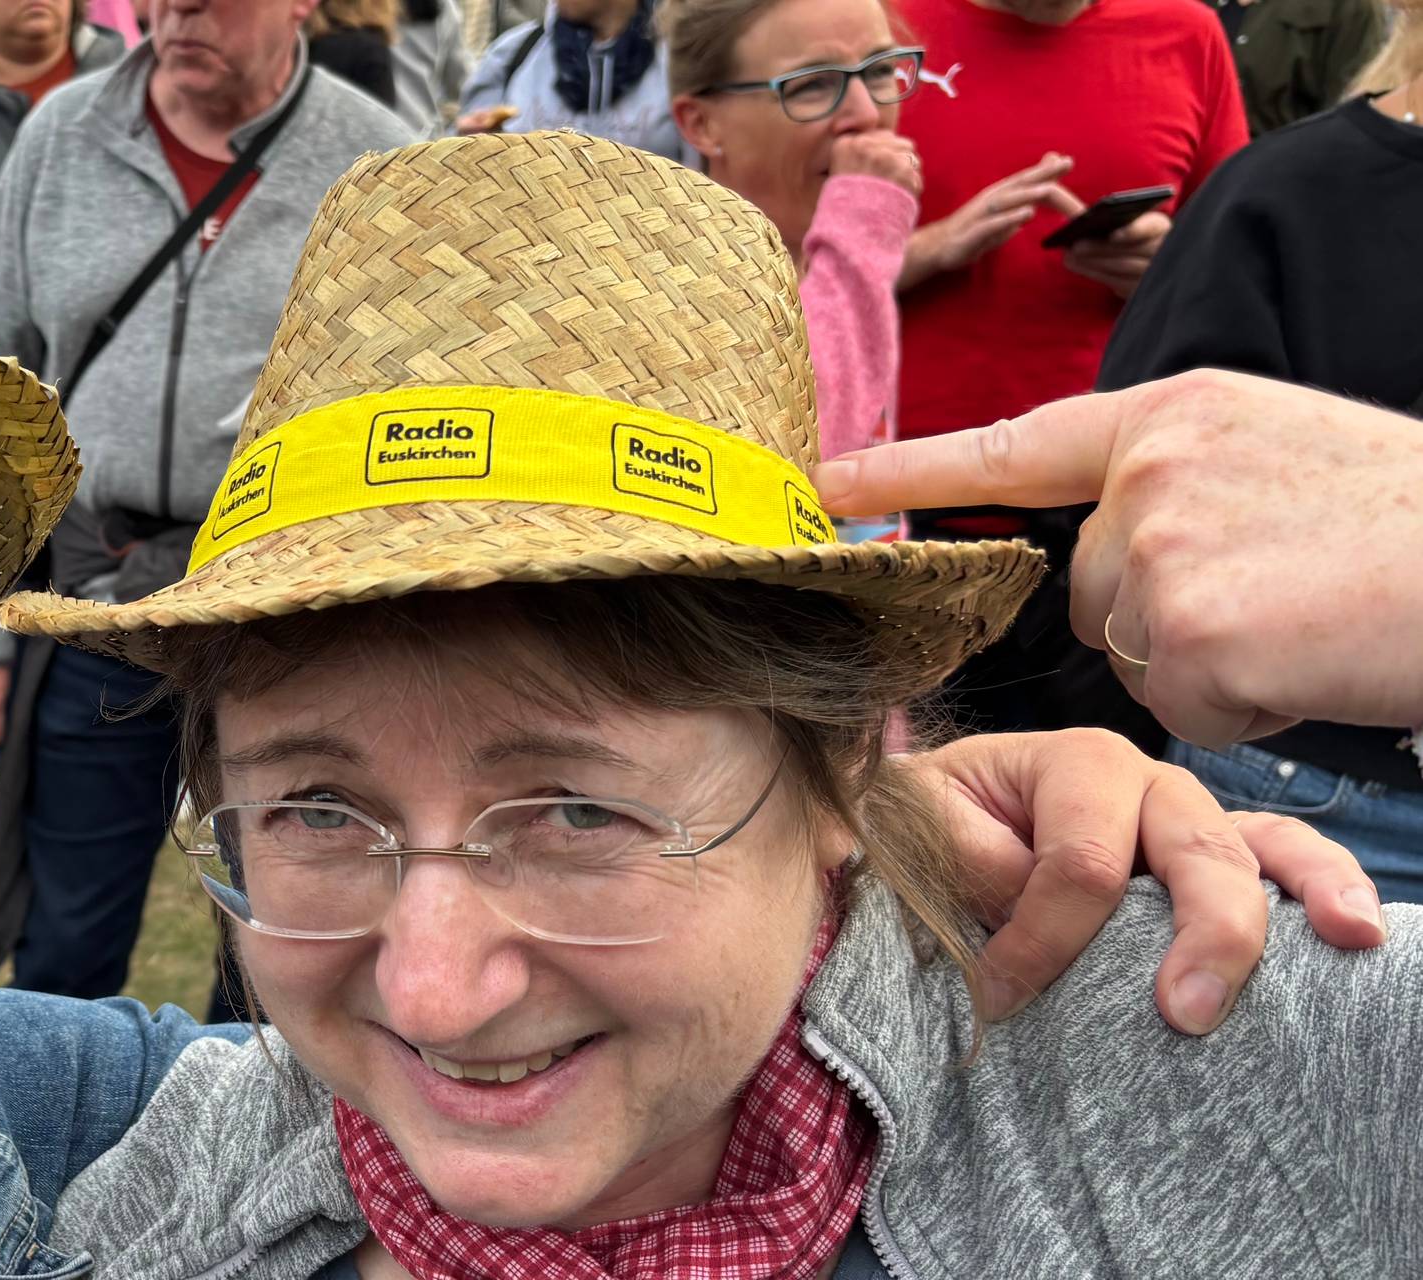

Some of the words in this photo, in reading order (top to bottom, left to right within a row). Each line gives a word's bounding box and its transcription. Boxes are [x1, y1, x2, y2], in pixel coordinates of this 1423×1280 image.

[386, 419, 474, 442] Radio
[378, 446, 476, 464] Euskirchen
[629, 437, 702, 474] Radio
[229, 461, 267, 496] Radio
[624, 462, 706, 496] Euskirchen
